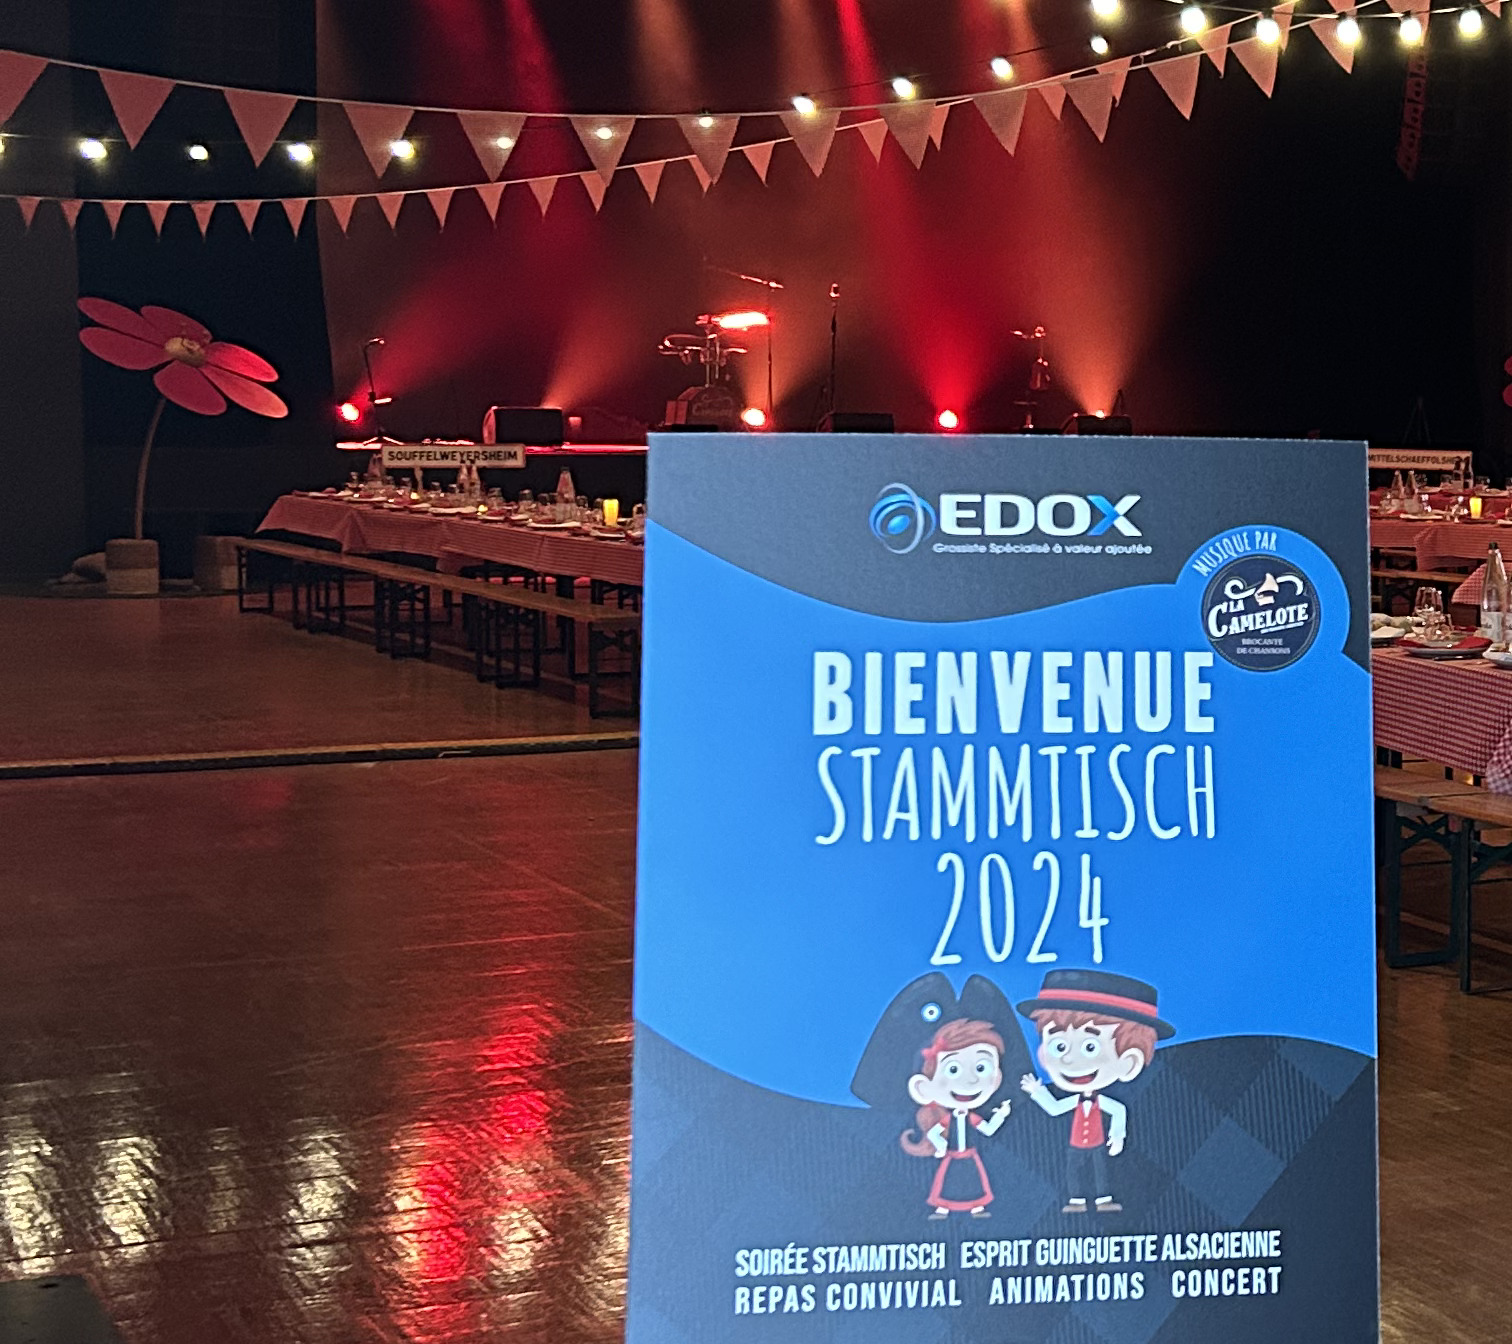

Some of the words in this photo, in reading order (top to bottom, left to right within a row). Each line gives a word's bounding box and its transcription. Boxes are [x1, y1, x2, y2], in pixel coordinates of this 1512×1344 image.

[388, 450, 518, 462] SOUFFELWEYERSHEIM
[939, 493, 1143, 537] EDOX
[989, 543, 1051, 555] Spécialisé
[1052, 544, 1063, 554] à
[1064, 543, 1103, 554] valeur
[1104, 543, 1153, 556] ajoutée
[1192, 531, 1252, 577] MUSIQUE
[1254, 530, 1278, 552] PAR
[1208, 602, 1309, 638] CAMELOTE
[1229, 600, 1245, 613] LA
[812, 650, 1216, 737] BIENVENUE
[814, 743, 1216, 845] STAMMTISCH
[929, 851, 1110, 967] 2024
[734, 1242, 809, 1278] SOIRÉE
[811, 1242, 946, 1274] STAMMTISCH
[960, 1239, 1032, 1269] ESPRIT
[1035, 1234, 1158, 1266] GUINGUETTE
[1160, 1229, 1282, 1261] ALSACIENNE
[734, 1284, 816, 1315] REPAS
[825, 1278, 962, 1312] CONVIVIAL
[988, 1271, 1145, 1306] ANIMATIONS
[1171, 1266, 1282, 1299] CONCERT
